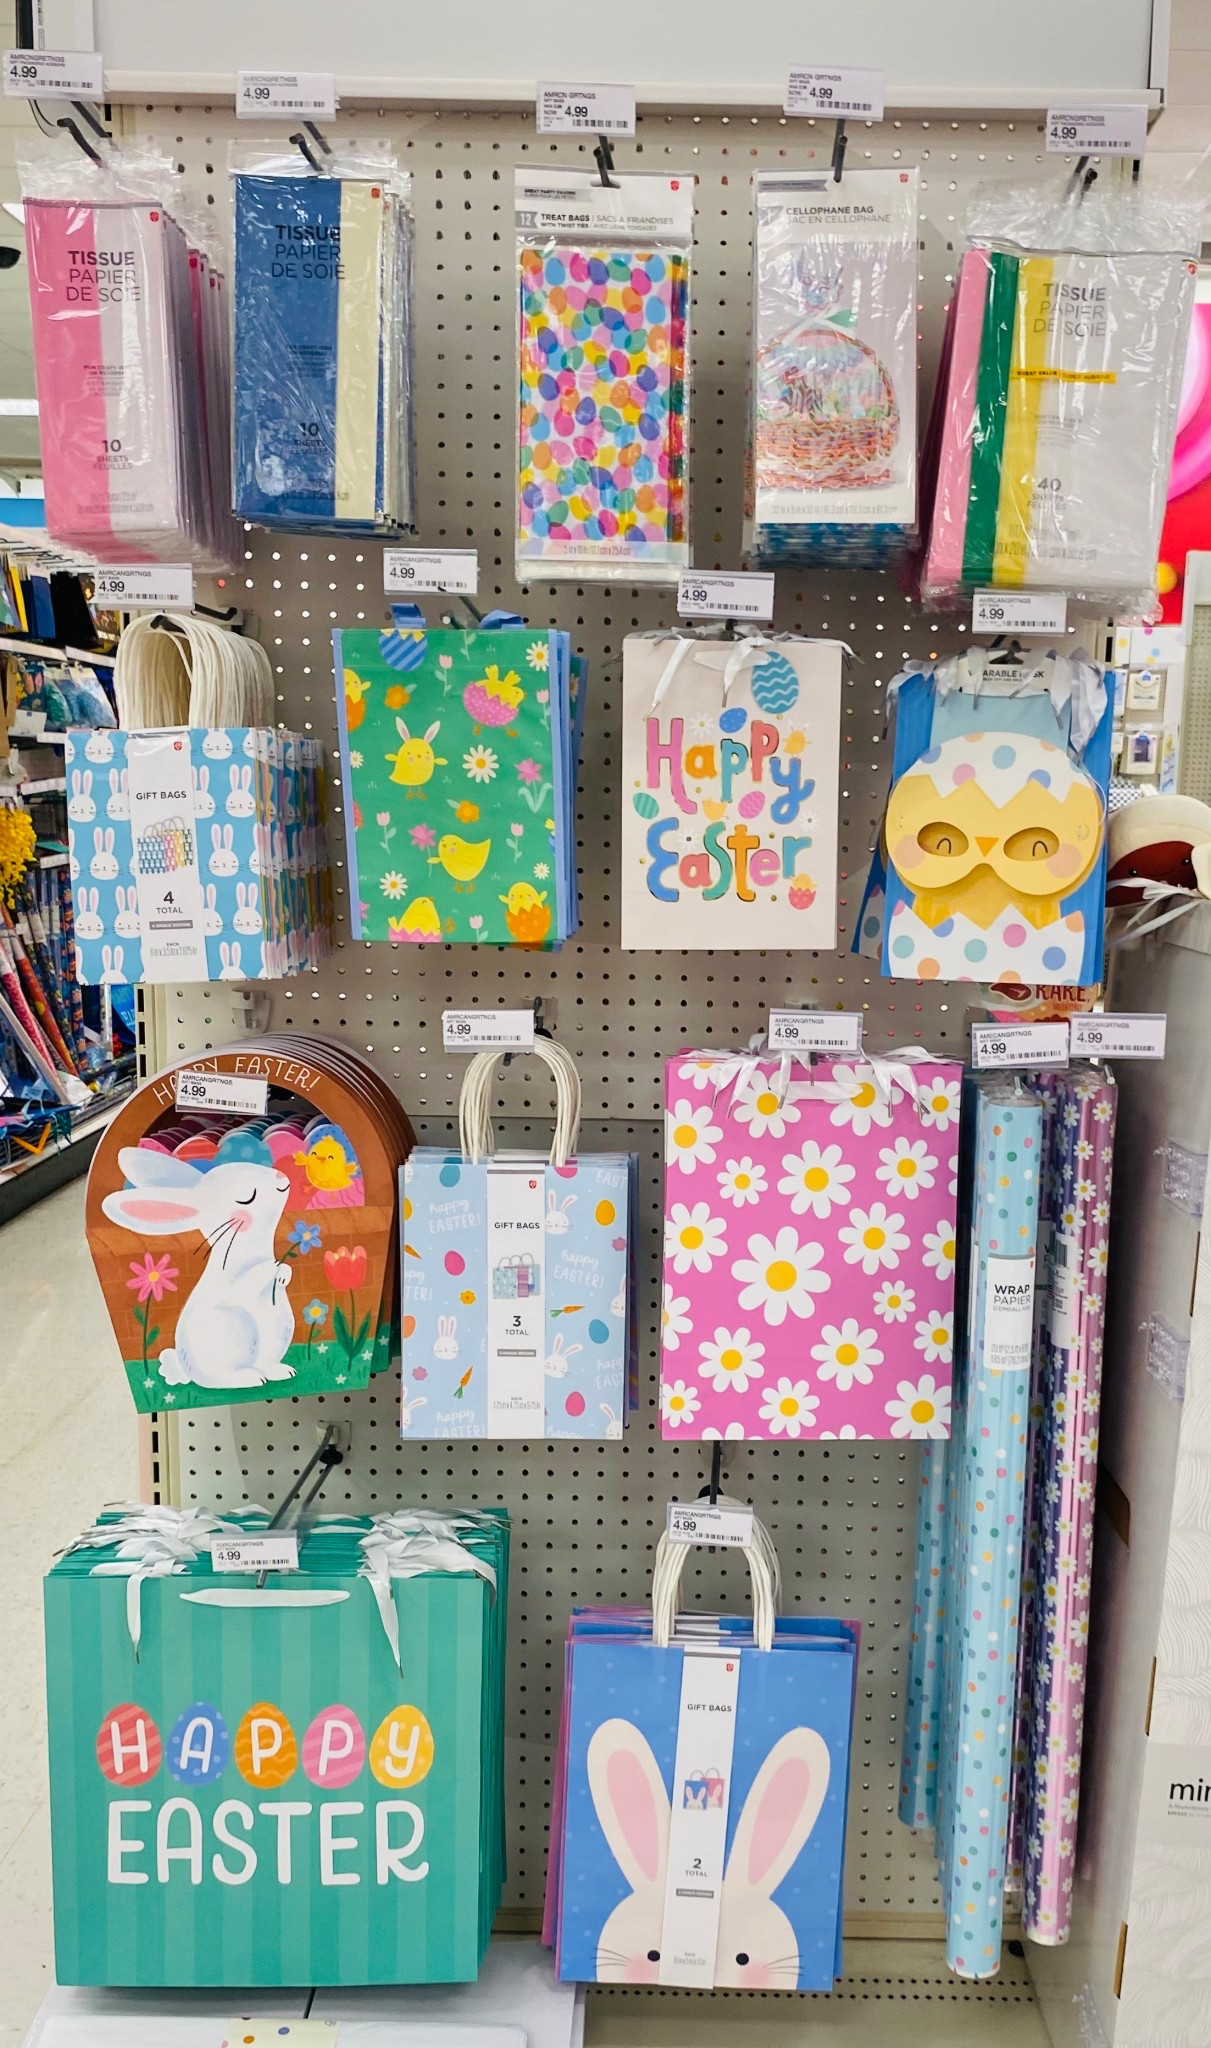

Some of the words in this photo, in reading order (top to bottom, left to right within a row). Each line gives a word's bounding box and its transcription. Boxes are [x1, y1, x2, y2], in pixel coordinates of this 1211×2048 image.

[10, 65, 37, 78] 4.99
[244, 87, 270, 99] 4.99
[809, 87, 833, 99] 4.99
[565, 106, 588, 117] 4.99
[1050, 126, 1077, 139] 4.99
[786, 206, 850, 215] CELLOPHANE
[854, 206, 874, 214] BAG
[520, 213, 532, 226] 12
[541, 213, 566, 221] TREAT
[569, 214, 590, 222] BAGS
[596, 215, 617, 223] SACS
[627, 217, 674, 225] FRIANDISES
[825, 214, 892, 224] CELLOPHANE
[275, 225, 341, 241] TISSUE
[68, 251, 135, 266] TISSUE
[275, 244, 341, 260] PAPIER
[70, 268, 137, 284] PAPIER
[272, 263, 297, 279] DE
[302, 264, 346, 280] SOIE
[66, 286, 92, 302] DE
[1043, 283, 1107, 301] TISSUE
[1040, 300, 1105, 319] PAPIER
[1033, 318, 1056, 333] DE
[1064, 321, 1107, 337] SOIE
[299, 422, 319, 437] 10
[102, 439, 122, 453] 10
[97, 455, 129, 463] SHEETS
[1038, 477, 1062, 492] 40
[390, 567, 415, 579] 4.99
[99, 581, 125, 592] 4.99
[682, 589, 707, 601] 4.99
[979, 608, 1004, 619] 4.99
[969, 669, 1017, 678] ARABLE
[646, 717, 815, 825] Happy
[136, 792, 157, 800] GIFT
[160, 791, 187, 800] BAGS
[646, 817, 812, 902] Easter
[163, 891, 174, 904] 4
[447, 1024, 471, 1034] 4.99
[775, 1028, 799, 1038] 4.99
[1077, 1032, 1102, 1043] 4.99
[981, 1043, 1006, 1054] 4.99
[235, 1056, 321, 1092] EASTER!
[181, 1084, 206, 1097] 4.99
[428, 1199, 470, 1214] happy
[428, 1212, 481, 1234] EASTER!
[561, 1249, 599, 1271] happy
[553, 1265, 605, 1288] EASTER!
[995, 1284, 1030, 1294] WRAP
[994, 1295, 1031, 1306] PAPIER
[513, 1315, 522, 1327] 3
[437, 1409, 475, 1423] happy
[673, 1520, 697, 1531] 4.99
[218, 1551, 241, 1561] 4.99
[709, 1704, 732, 1712] BAGS
[110, 1716, 420, 1779] HAPPY
[107, 1797, 430, 1886] EASTER
[693, 1858, 702, 1869] 2
